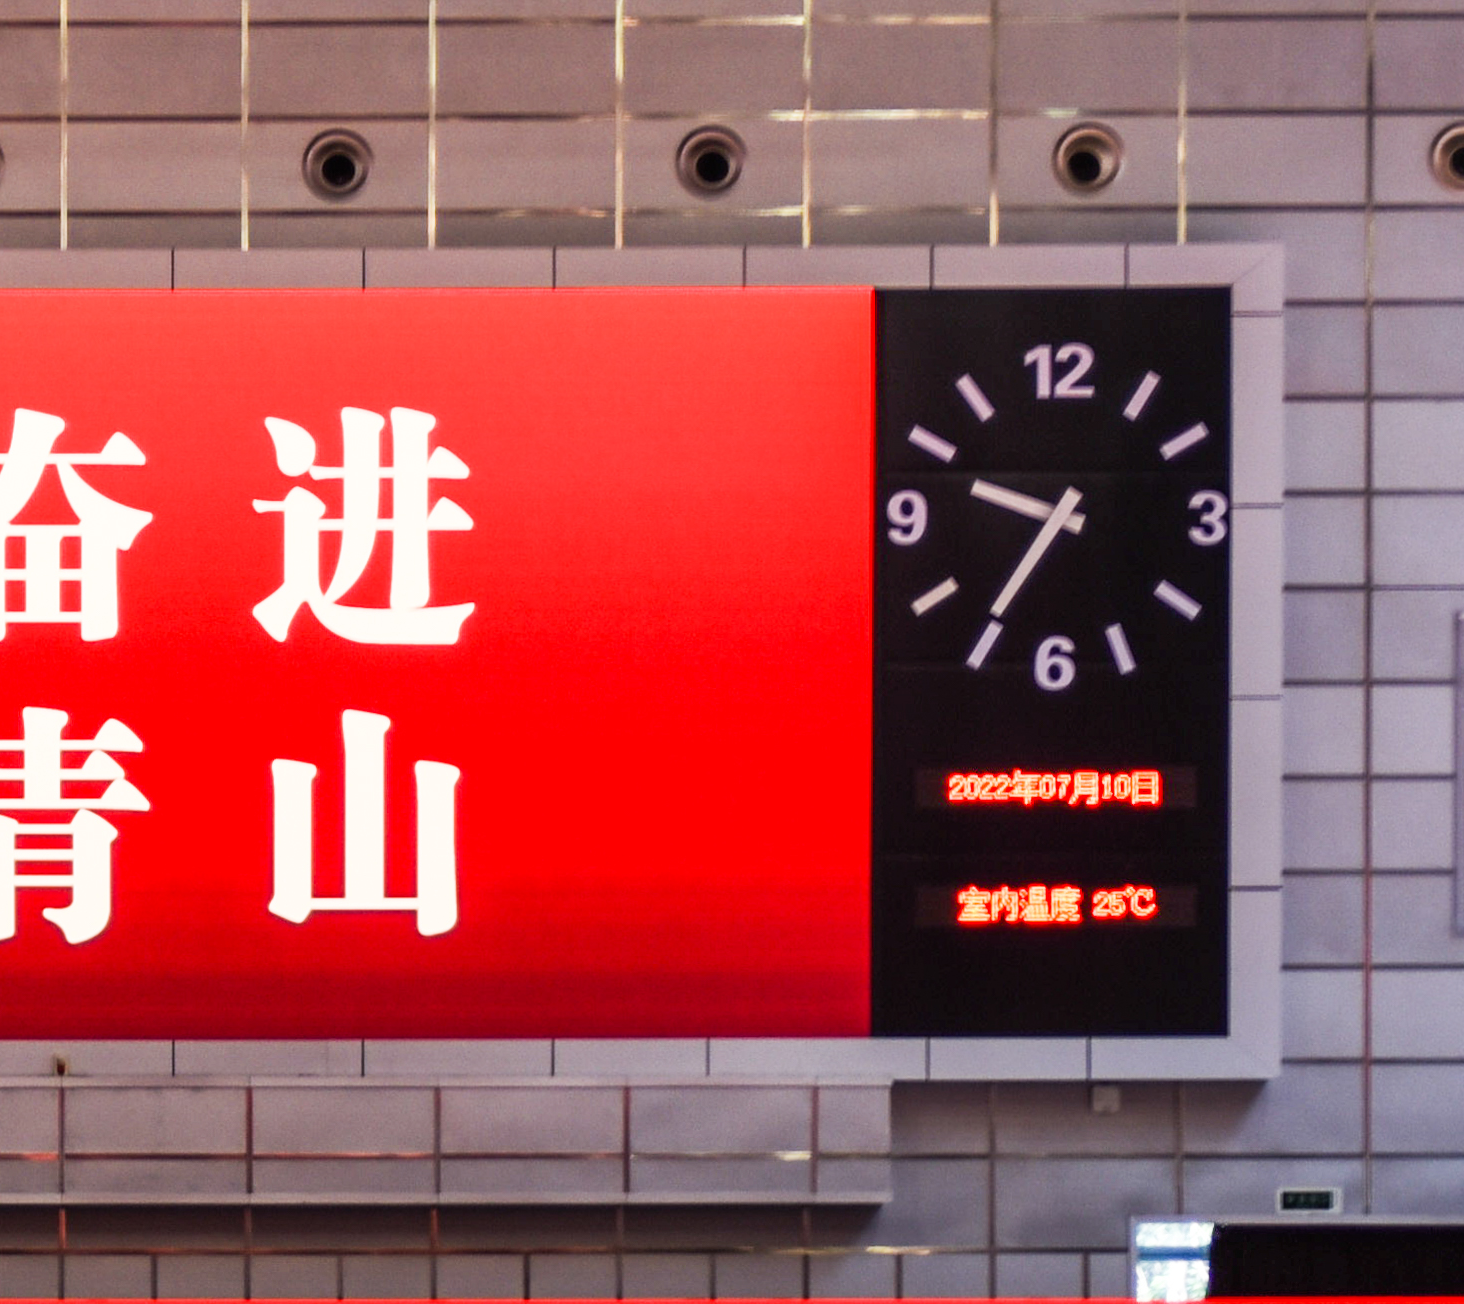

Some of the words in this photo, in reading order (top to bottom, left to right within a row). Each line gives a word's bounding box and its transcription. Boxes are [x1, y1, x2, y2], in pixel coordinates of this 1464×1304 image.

[1024, 345, 1094, 398] 12
[887, 491, 927, 545] 9
[1189, 492, 1226, 544] 3
[1035, 637, 1074, 690] 6
[946, 768, 1163, 807] 2022年07月10日
[956, 884, 1083, 926] 室内温度
